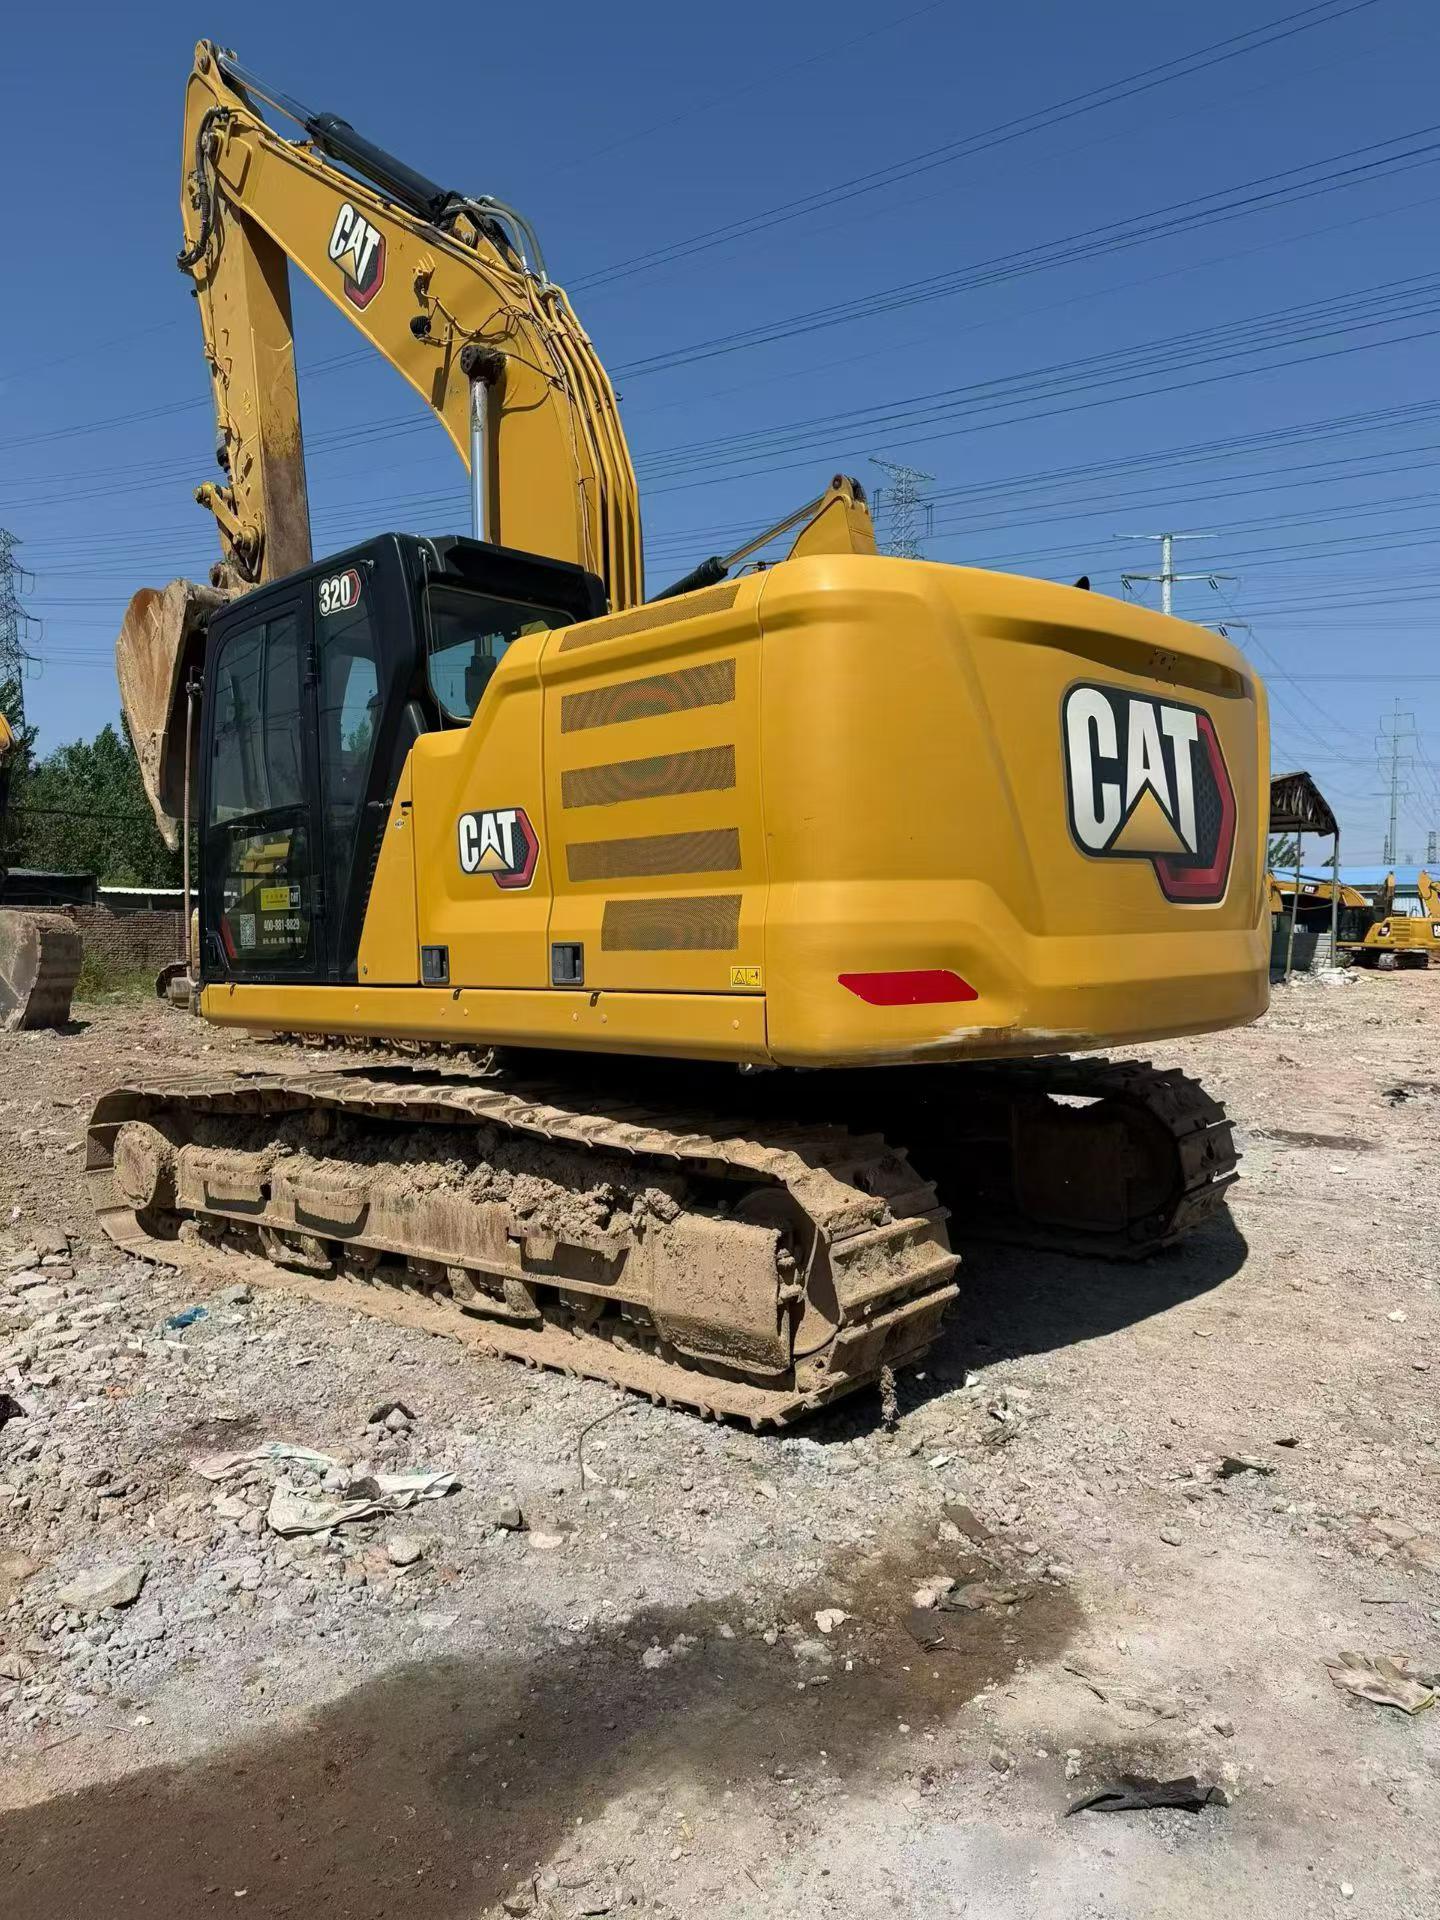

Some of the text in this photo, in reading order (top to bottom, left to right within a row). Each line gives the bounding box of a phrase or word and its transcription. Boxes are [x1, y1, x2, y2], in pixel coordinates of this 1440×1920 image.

[329, 203, 380, 285] CAT
[320, 575, 350, 612] 320
[1066, 688, 1199, 853] CAT
[459, 810, 516, 872] CAT
